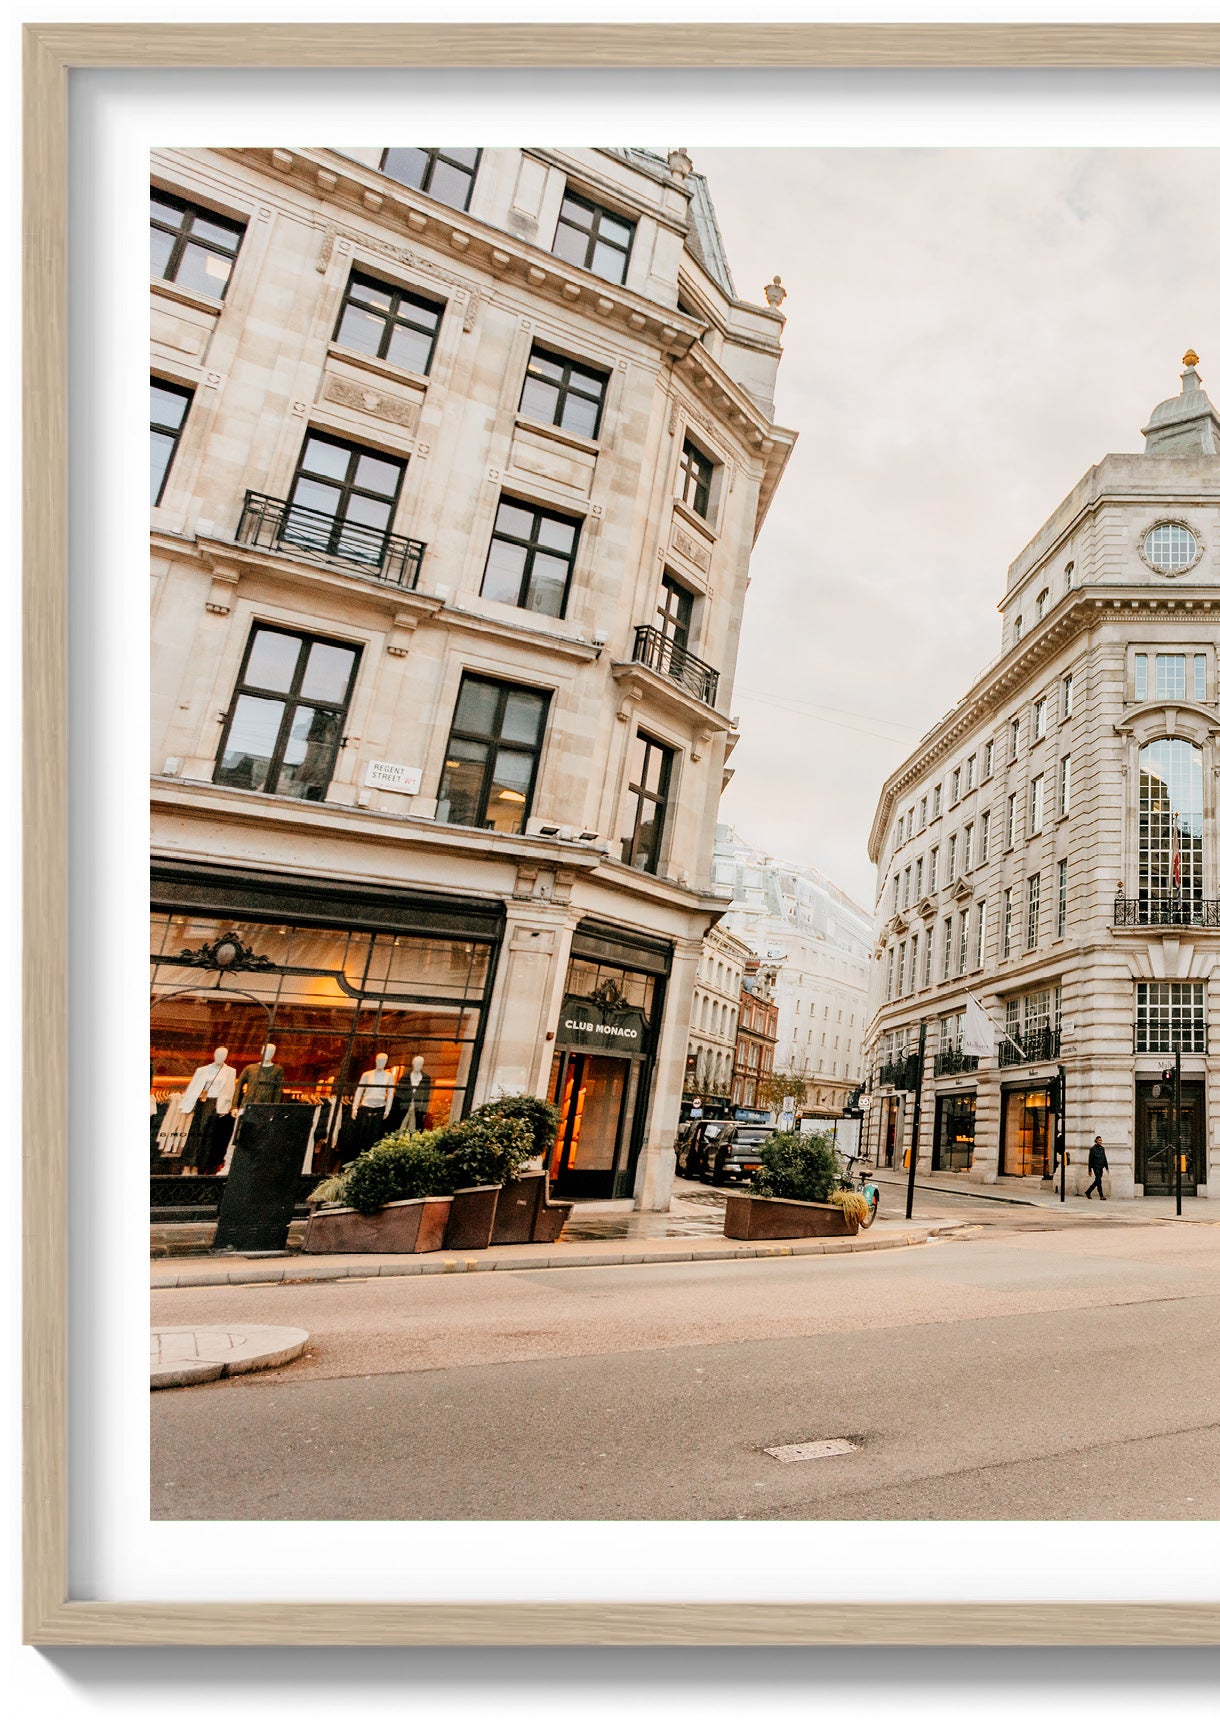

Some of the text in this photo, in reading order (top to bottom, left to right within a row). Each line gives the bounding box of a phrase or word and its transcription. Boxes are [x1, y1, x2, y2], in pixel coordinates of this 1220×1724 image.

[373, 763, 405, 775] REGENT
[371, 771, 401, 782] STREET
[564, 1019, 638, 1038] CLUB MONACO
